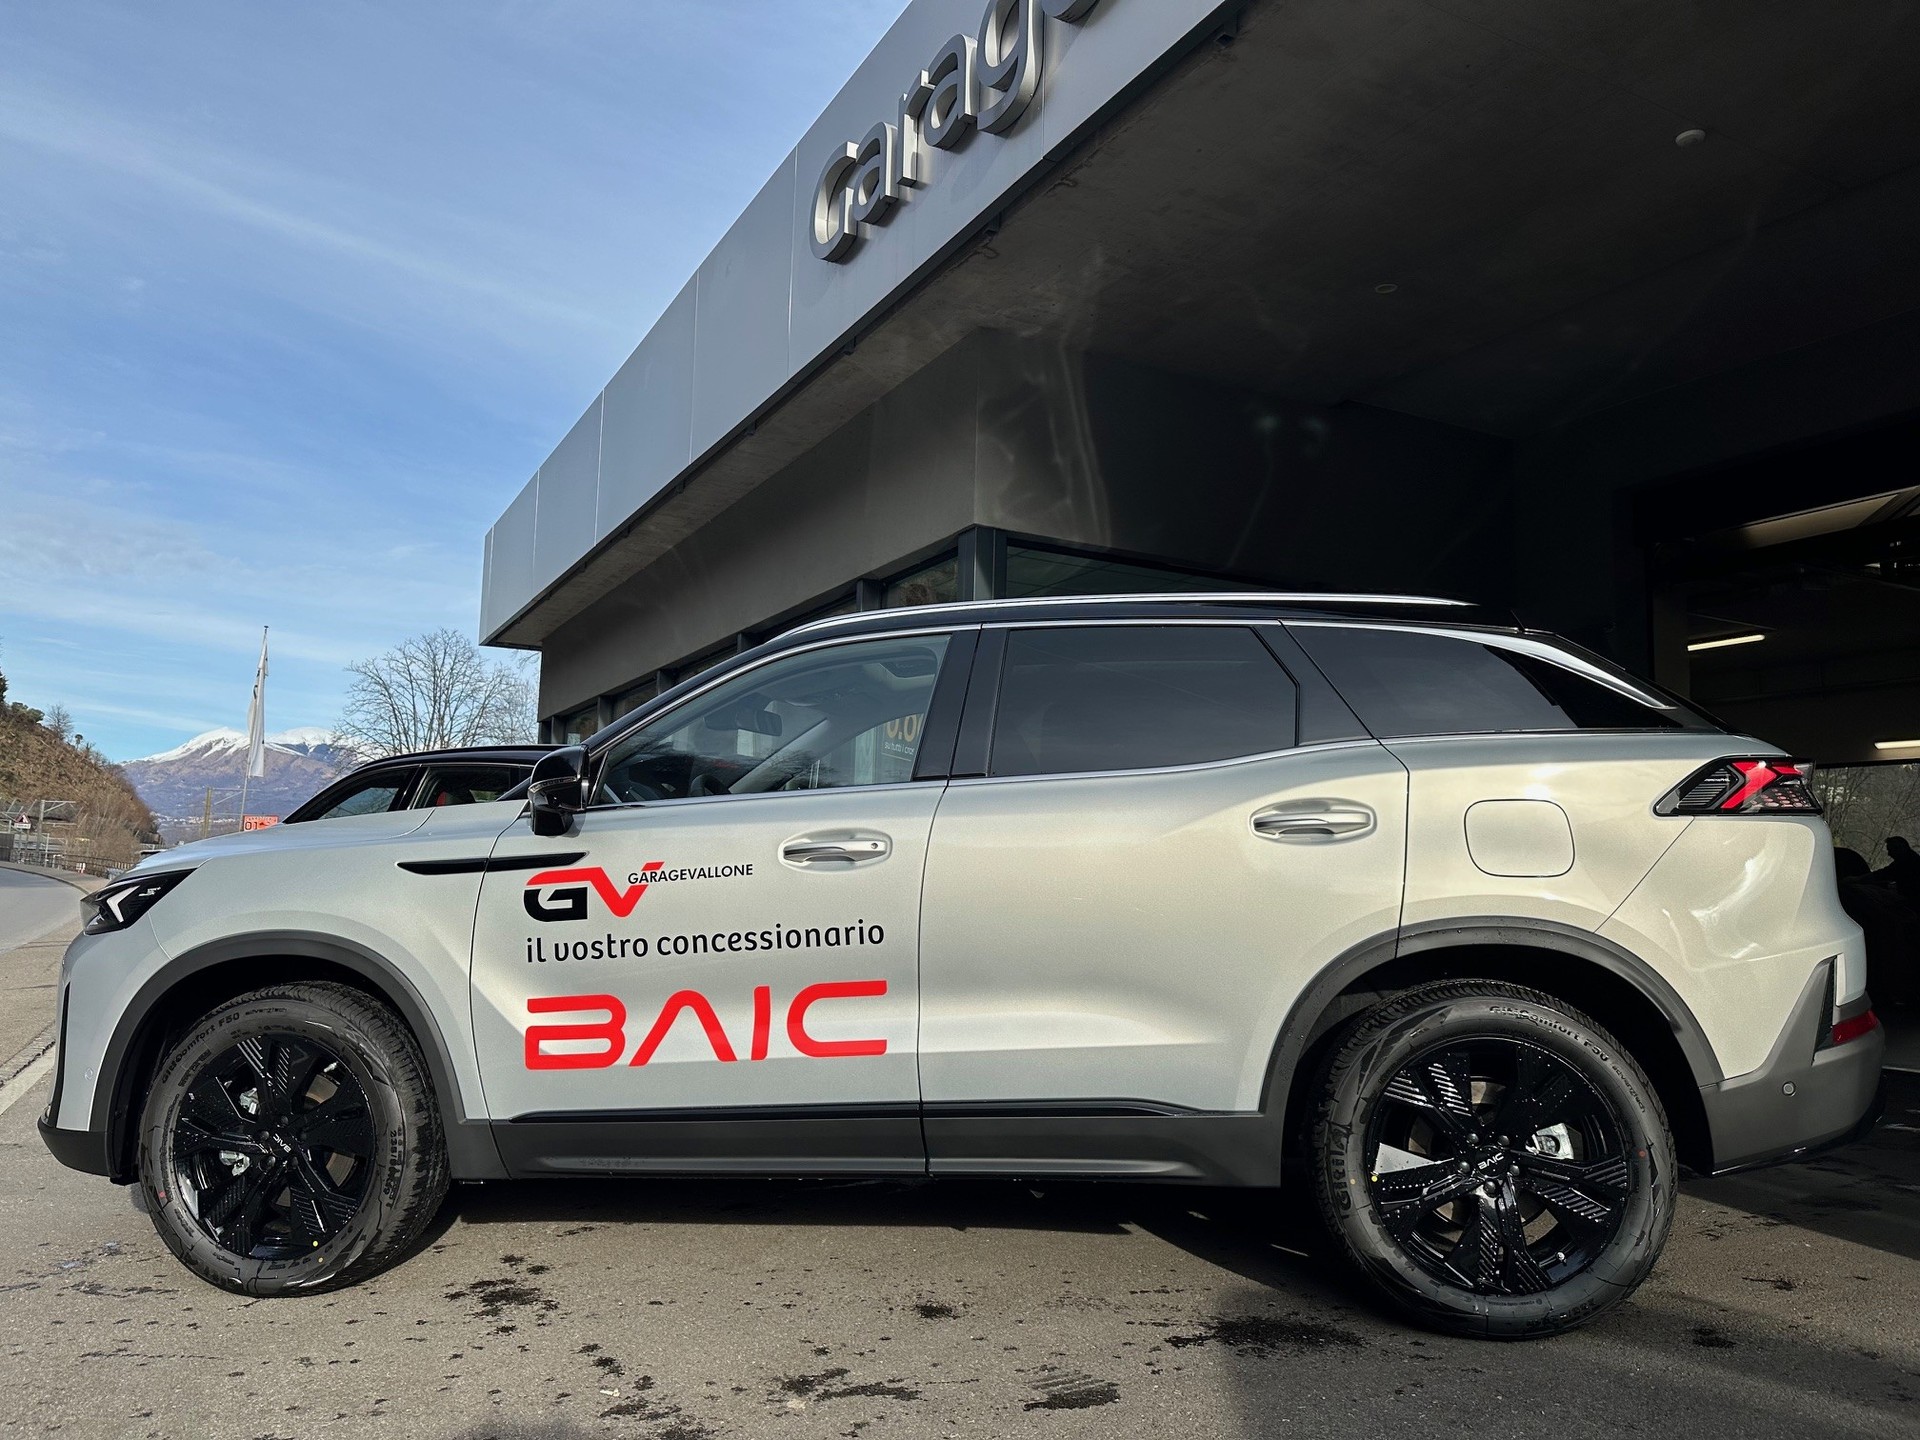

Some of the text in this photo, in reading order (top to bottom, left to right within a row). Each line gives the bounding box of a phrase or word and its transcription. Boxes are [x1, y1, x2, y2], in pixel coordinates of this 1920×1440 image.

[809, 0, 1098, 263] Garag
[627, 863, 753, 885] GARAGEVALLONE
[526, 918, 885, 963] il vostro concessionario
[218, 1012, 240, 1028] F50
[525, 980, 887, 1070] BAIC
